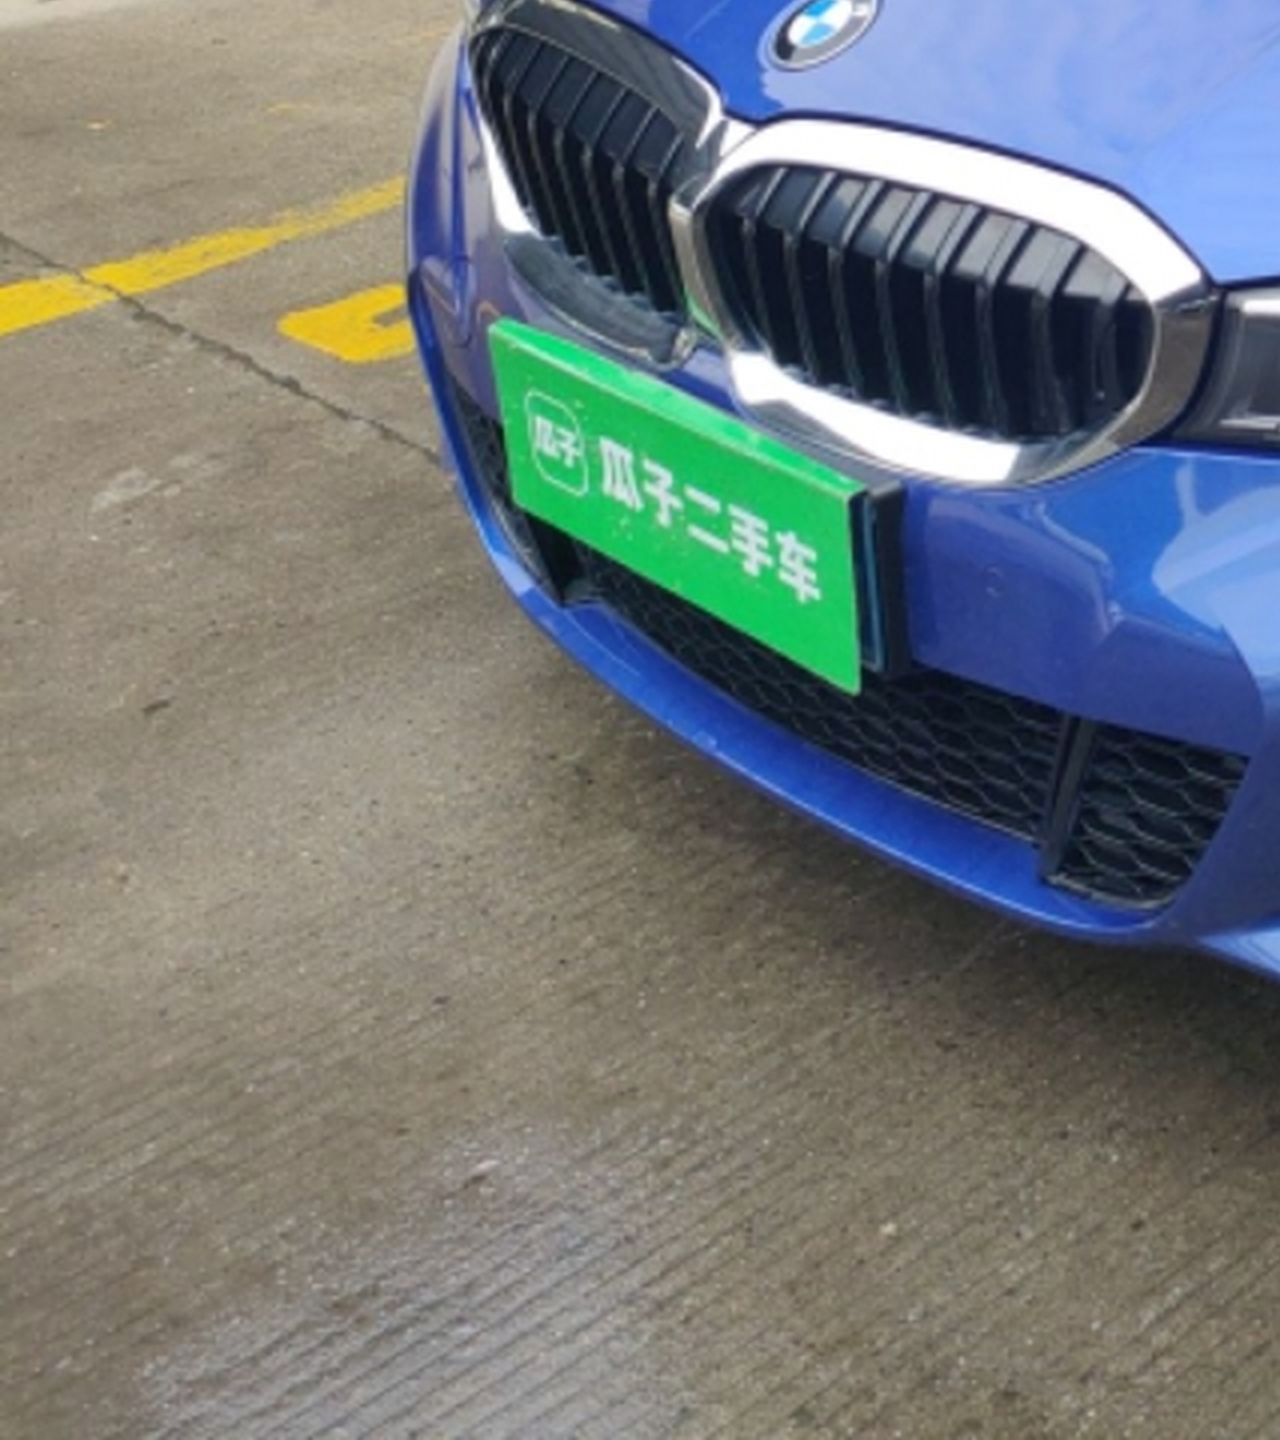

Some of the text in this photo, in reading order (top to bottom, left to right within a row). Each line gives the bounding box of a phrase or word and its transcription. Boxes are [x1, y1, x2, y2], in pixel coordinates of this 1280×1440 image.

[599, 436, 821, 604] 瓜子二手车
